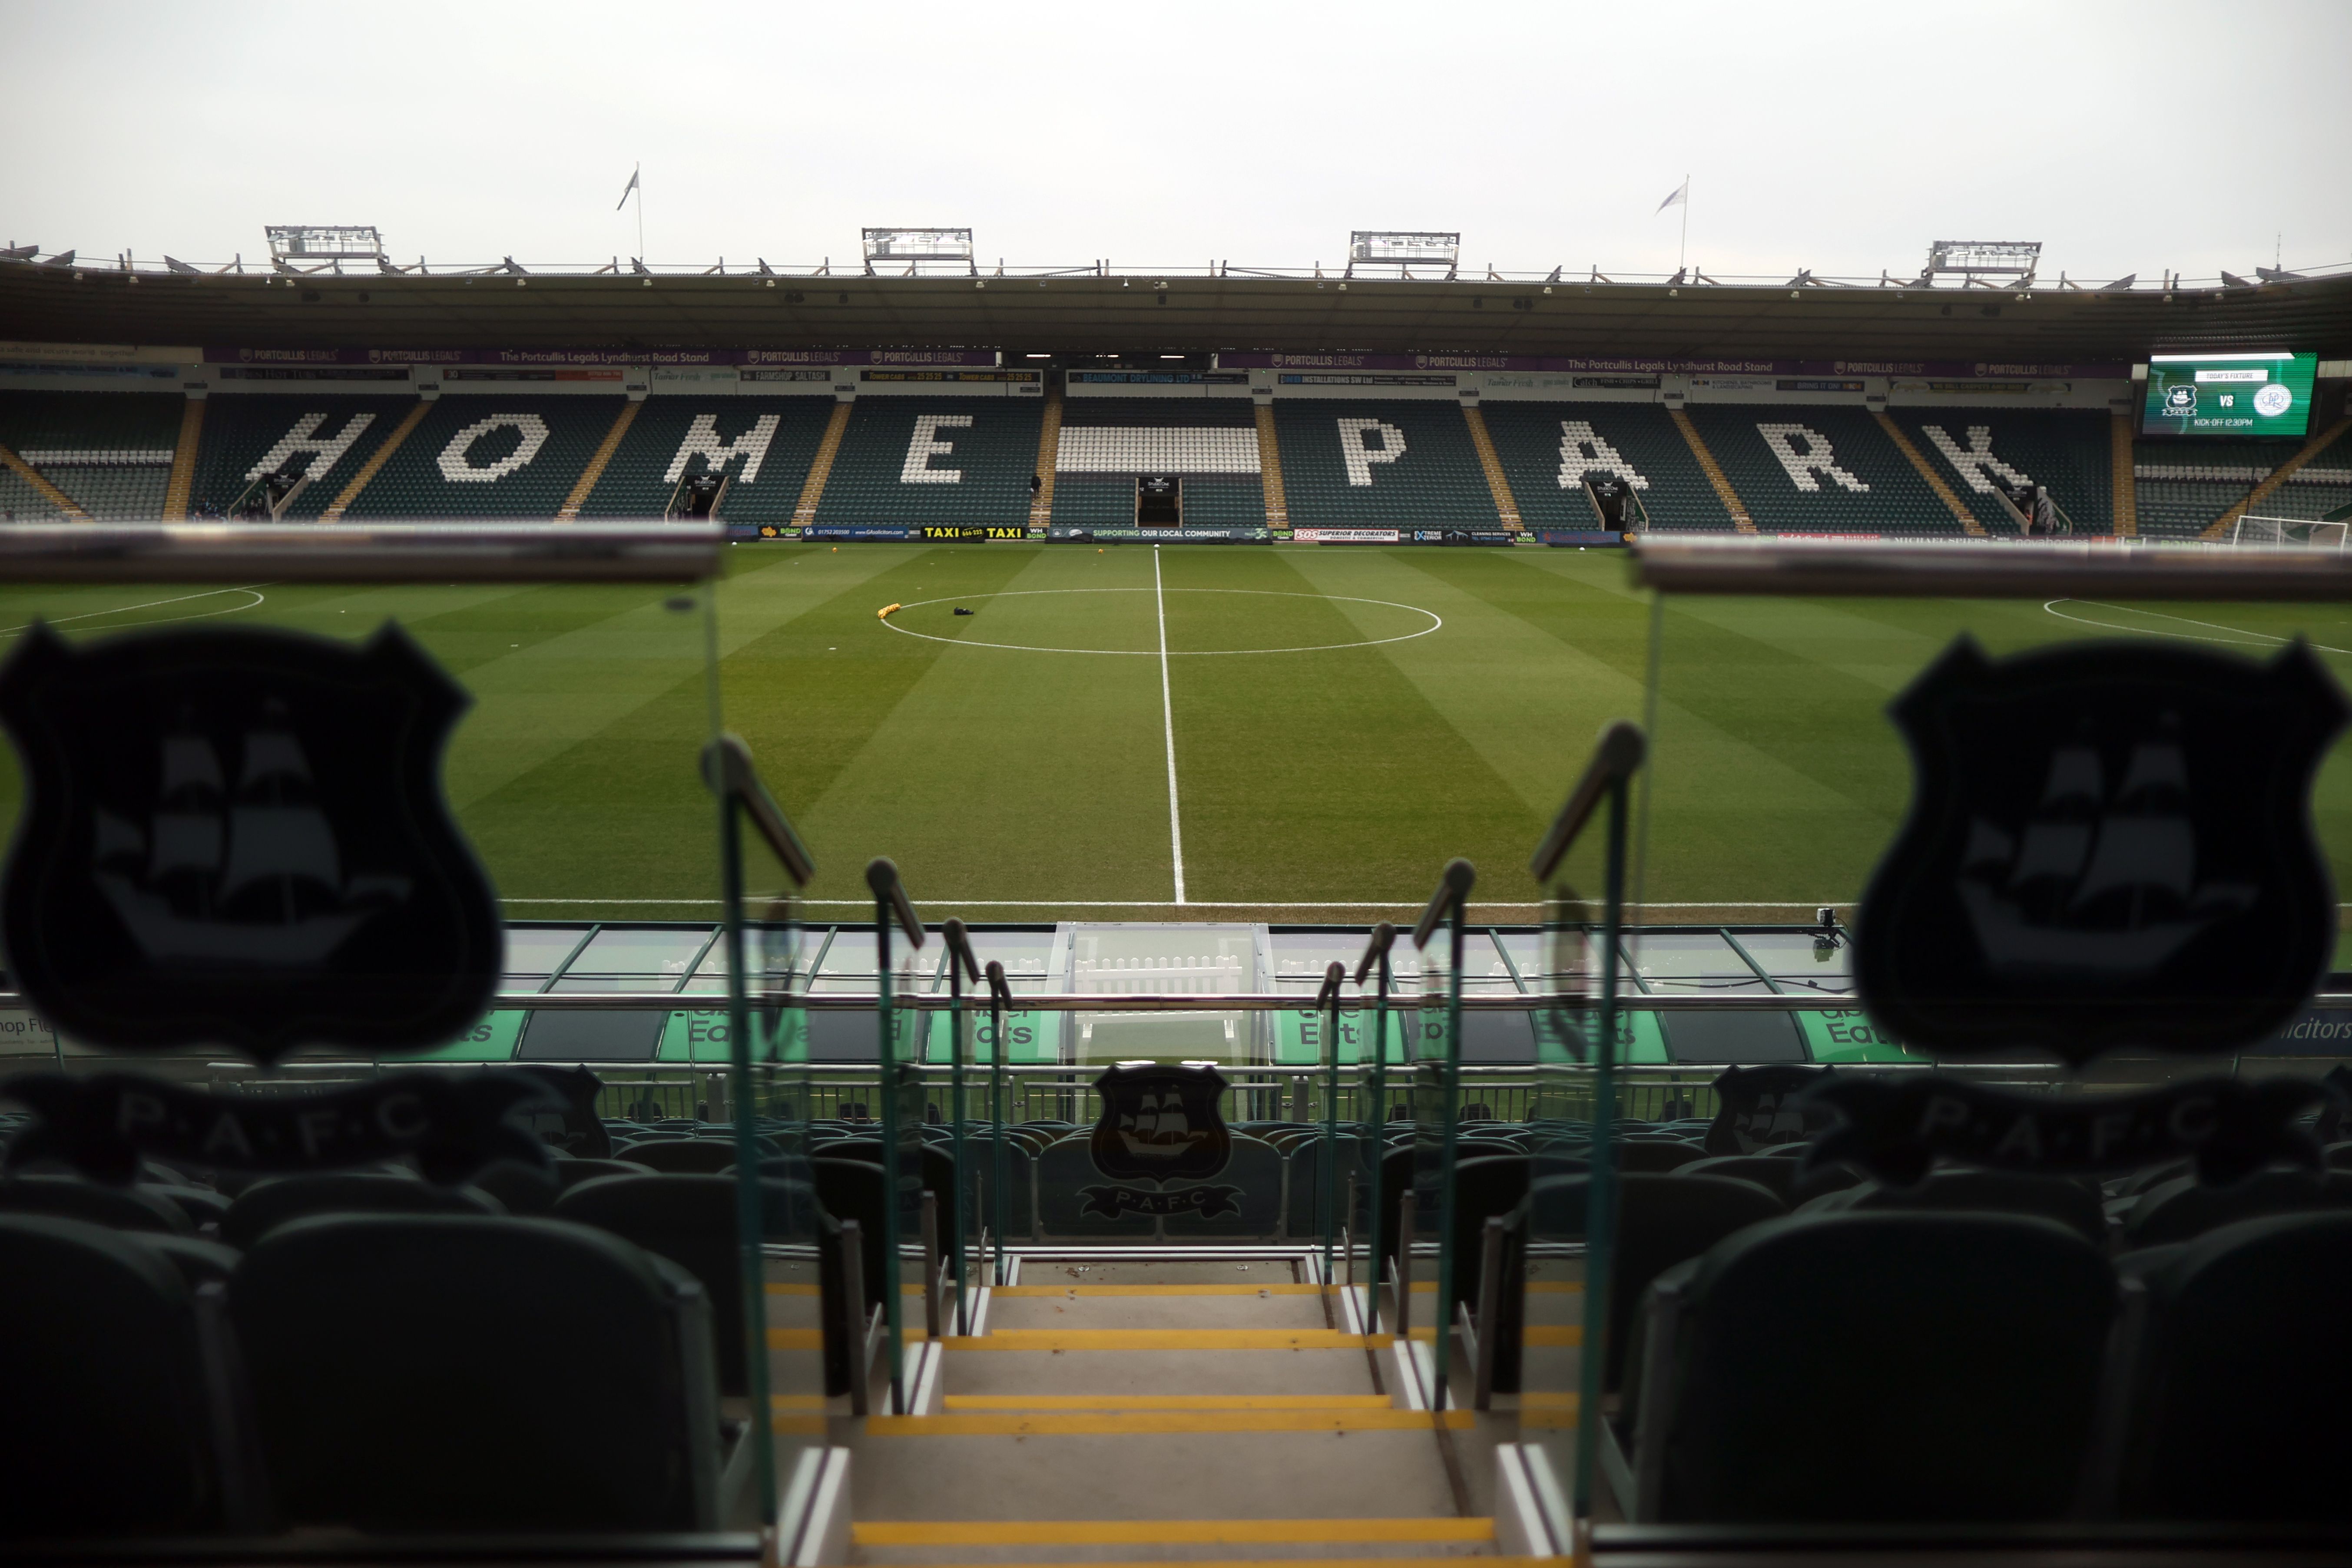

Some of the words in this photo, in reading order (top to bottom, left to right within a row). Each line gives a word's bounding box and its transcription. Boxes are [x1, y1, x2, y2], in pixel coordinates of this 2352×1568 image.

[255, 350, 305, 360] PORTCULLIS
[383, 351, 430, 361] PORTCULLIS
[500, 351, 519, 361] The
[522, 351, 566, 362] Portcullis
[568, 352, 600, 364] Legals
[602, 352, 650, 364] Lyndhurst
[653, 352, 678, 362] Road
[680, 352, 709, 362] Stand
[762, 351, 809, 361] PORTCULLIS
[885, 352, 932, 362] PORTCULLIS
[1286, 355, 1332, 365] PORTCULLIS
[1430, 357, 1476, 367] PORTCULLIS
[1568, 359, 1586, 369] The
[1589, 360, 1632, 370] Portcullis
[1635, 361, 1665, 372] Legals
[1668, 361, 1715, 372] Lyndhurst
[1718, 361, 1742, 371] Road
[1745, 362, 1773, 372] Stand
[1848, 363, 1893, 373] PORTCULLIS
[1989, 364, 2037, 374] PORTCULLIS
[756, 371, 792, 380] FARMSHOP
[795, 372, 825, 380] SALTASH
[1083, 373, 1127, 382] BEAUMONT
[1130, 374, 1173, 383] DRYLINING
[1176, 374, 1190, 383] LTD
[2220, 395, 2234, 407] VS
[924, 527, 959, 538] TAXI
[987, 528, 1021, 538] TAXI
[1296, 529, 1319, 539] SOS
[2016, 537, 2089, 547] novahomes
